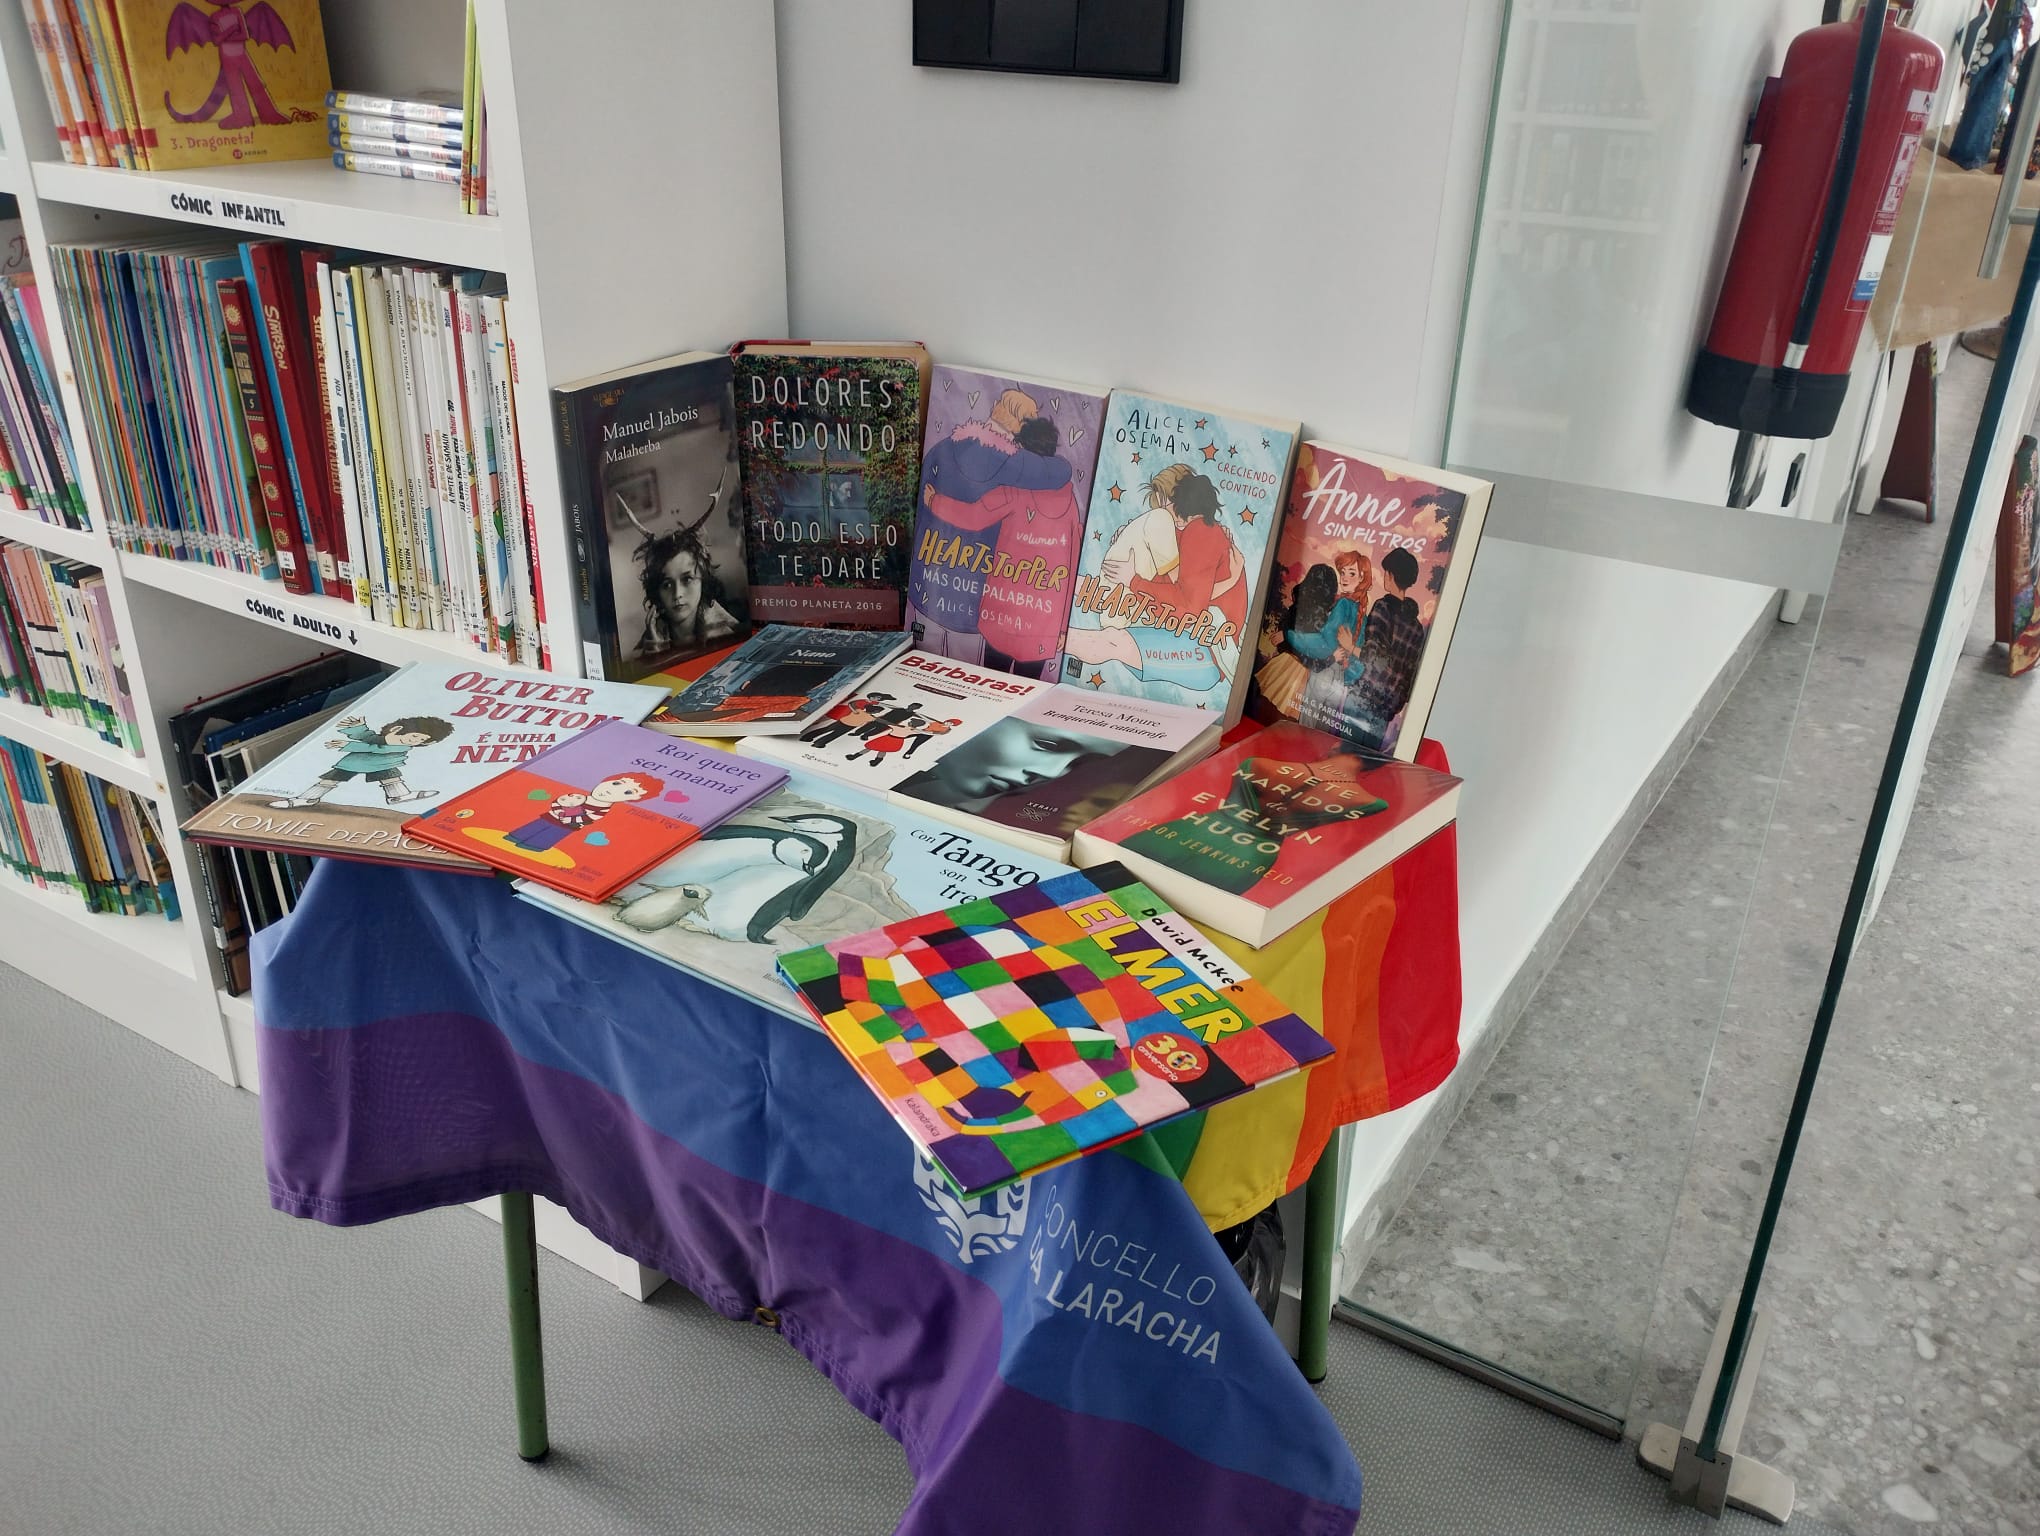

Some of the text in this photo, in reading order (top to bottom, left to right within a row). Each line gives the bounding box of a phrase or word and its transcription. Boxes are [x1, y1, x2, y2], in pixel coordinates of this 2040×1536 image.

[170, 131, 254, 152] 3. Dragoneta!
[170, 192, 285, 227] CÓMIC INFANTIL
[385, 289, 394, 325] AGRIPINA
[264, 304, 288, 370] SIMPSON
[752, 375, 892, 409] DOLORES
[602, 406, 699, 442] Manuel Jabois
[752, 420, 895, 453] REDONDO
[1127, 409, 1184, 434] ALICE
[606, 441, 661, 464] Malaherba
[1115, 428, 1191, 455] OSEMAN
[1217, 461, 1276, 485] CRECIENDO
[1219, 479, 1267, 500] CONTIGO
[526, 505, 532, 520] DE
[574, 504, 584, 533] JABOIS
[758, 520, 898, 547] TODO ESTO
[1016, 531, 1068, 546] volumen 4
[1323, 521, 1427, 553] SIN FILTROS
[778, 552, 881, 580] TE DARÉ
[917, 528, 1069, 592] HEARTSTOPPER
[755, 598, 882, 611] PREMIO PLANETA 2016
[923, 567, 1053, 613] MÁS QUE PALABRAS
[246, 599, 342, 640] CÓMIC ADULTO
[936, 598, 1033, 631] ALICE OSEMAN
[1075, 574, 1237, 650] HEARTSTOPPER
[788, 649, 837, 658] Nano
[1145, 647, 1205, 662] VOLUMEN 5
[445, 671, 594, 706] OLIVER
[900, 655, 1035, 696] Bárbaras!
[1043, 710, 1168, 740] Benquerida catástrofe
[1071, 704, 1161, 728] Teresa Moure
[1318, 701, 1350, 723] PARENTE
[1321, 713, 1353, 738] PASCUAL
[476, 732, 556, 744] É UNHA
[631, 757, 744, 796] ser mamá
[656, 743, 761, 781] Roi quere
[1232, 769, 1365, 822] MARIDOS
[1276, 765, 1359, 801] SIETE
[674, 812, 694, 823] Ana
[1026, 801, 1059, 813] XERAIS
[1192, 791, 1322, 846] EVELYN
[1266, 800, 1289, 813] de
[217, 813, 324, 838] TOMIE
[1182, 811, 1281, 854] HUGO
[910, 829, 1041, 887] Con Tango
[1122, 815, 1293, 886] TAYLOR JENKINS REID
[939, 868, 968, 883] son
[1141, 908, 1244, 993] David McKee
[1066, 899, 1243, 1044] ELMER
[1137, 1045, 1179, 1082] aniversario
[1145, 1034, 1202, 1072] 30
[904, 1097, 941, 1137] kalandraka
[1045, 1184, 1217, 1306] CONCELLO
[1046, 1269, 1221, 1365] LARACHA
